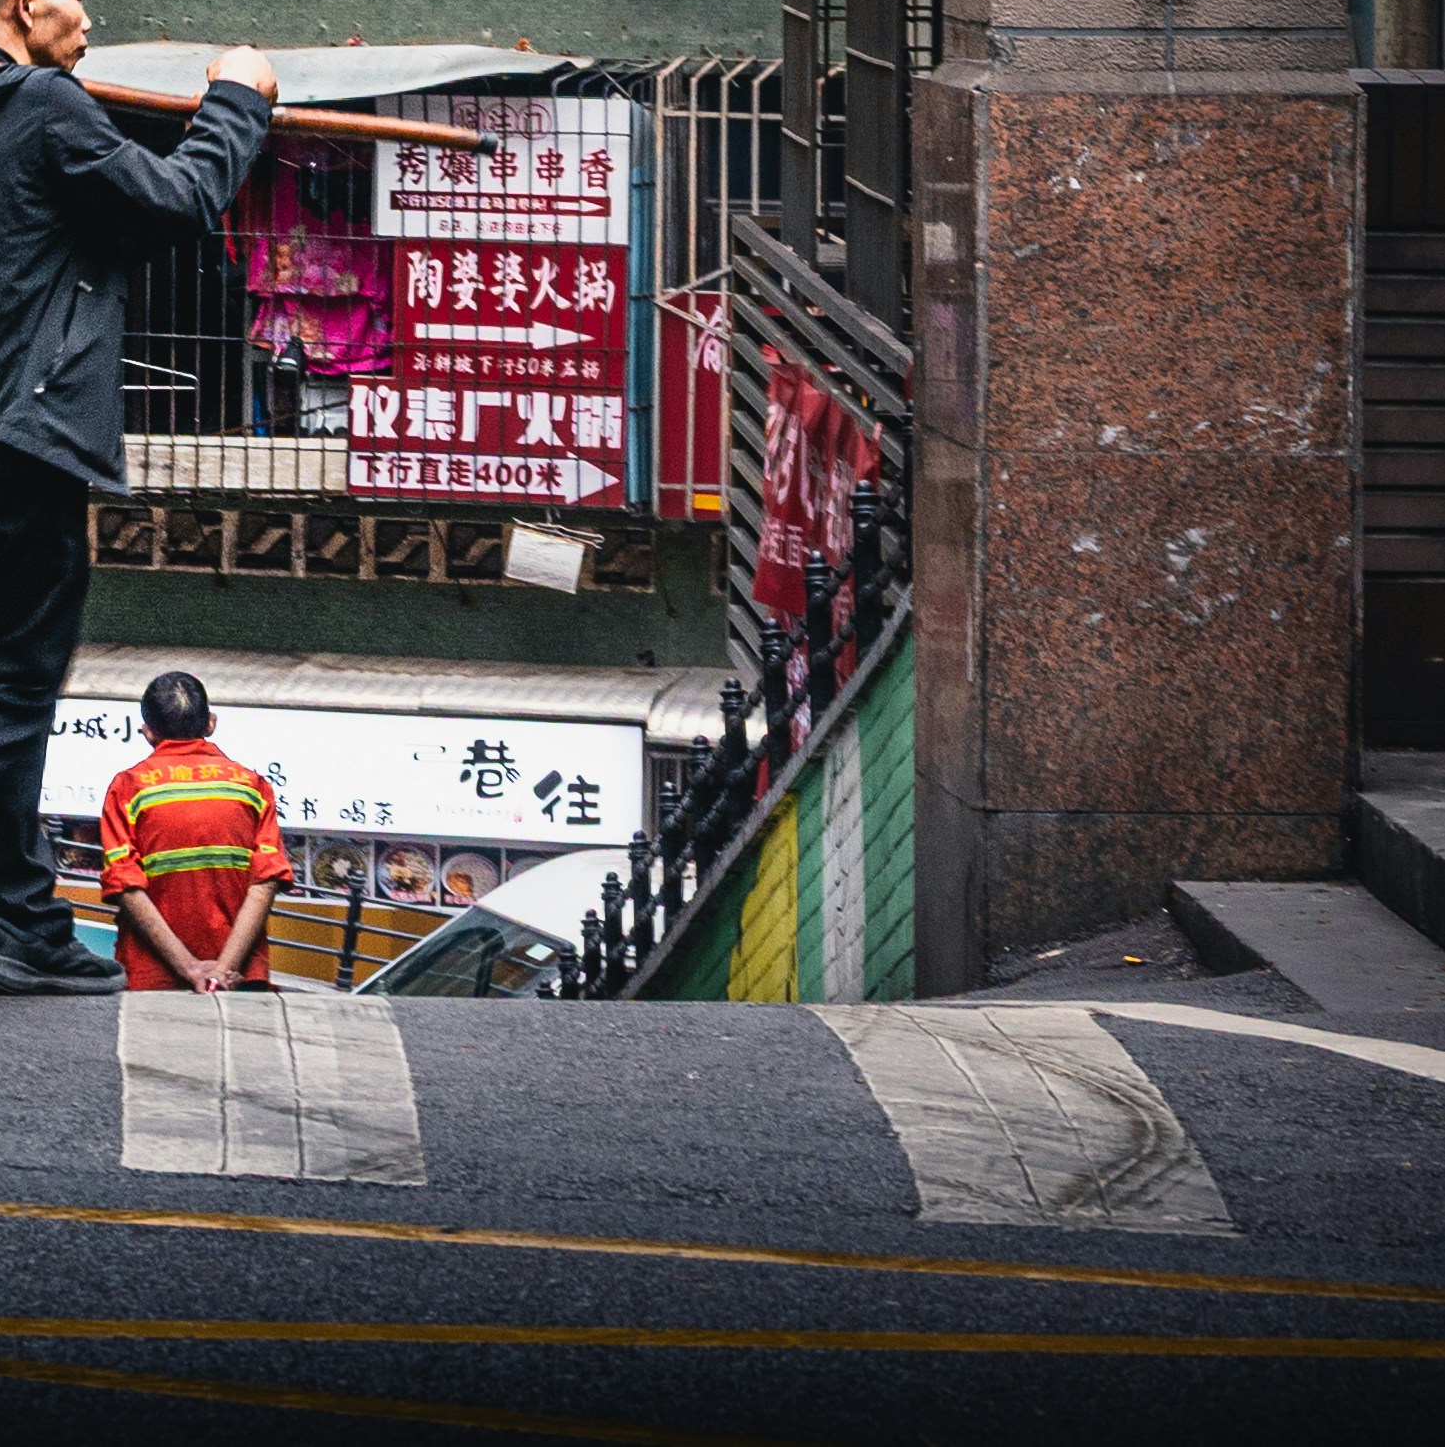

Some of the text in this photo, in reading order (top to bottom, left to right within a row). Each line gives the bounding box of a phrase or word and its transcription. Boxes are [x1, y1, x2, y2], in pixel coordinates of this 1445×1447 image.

[349, 383, 623, 449] 仪表厂火锅
[355, 453, 566, 491] 下行直走400米
